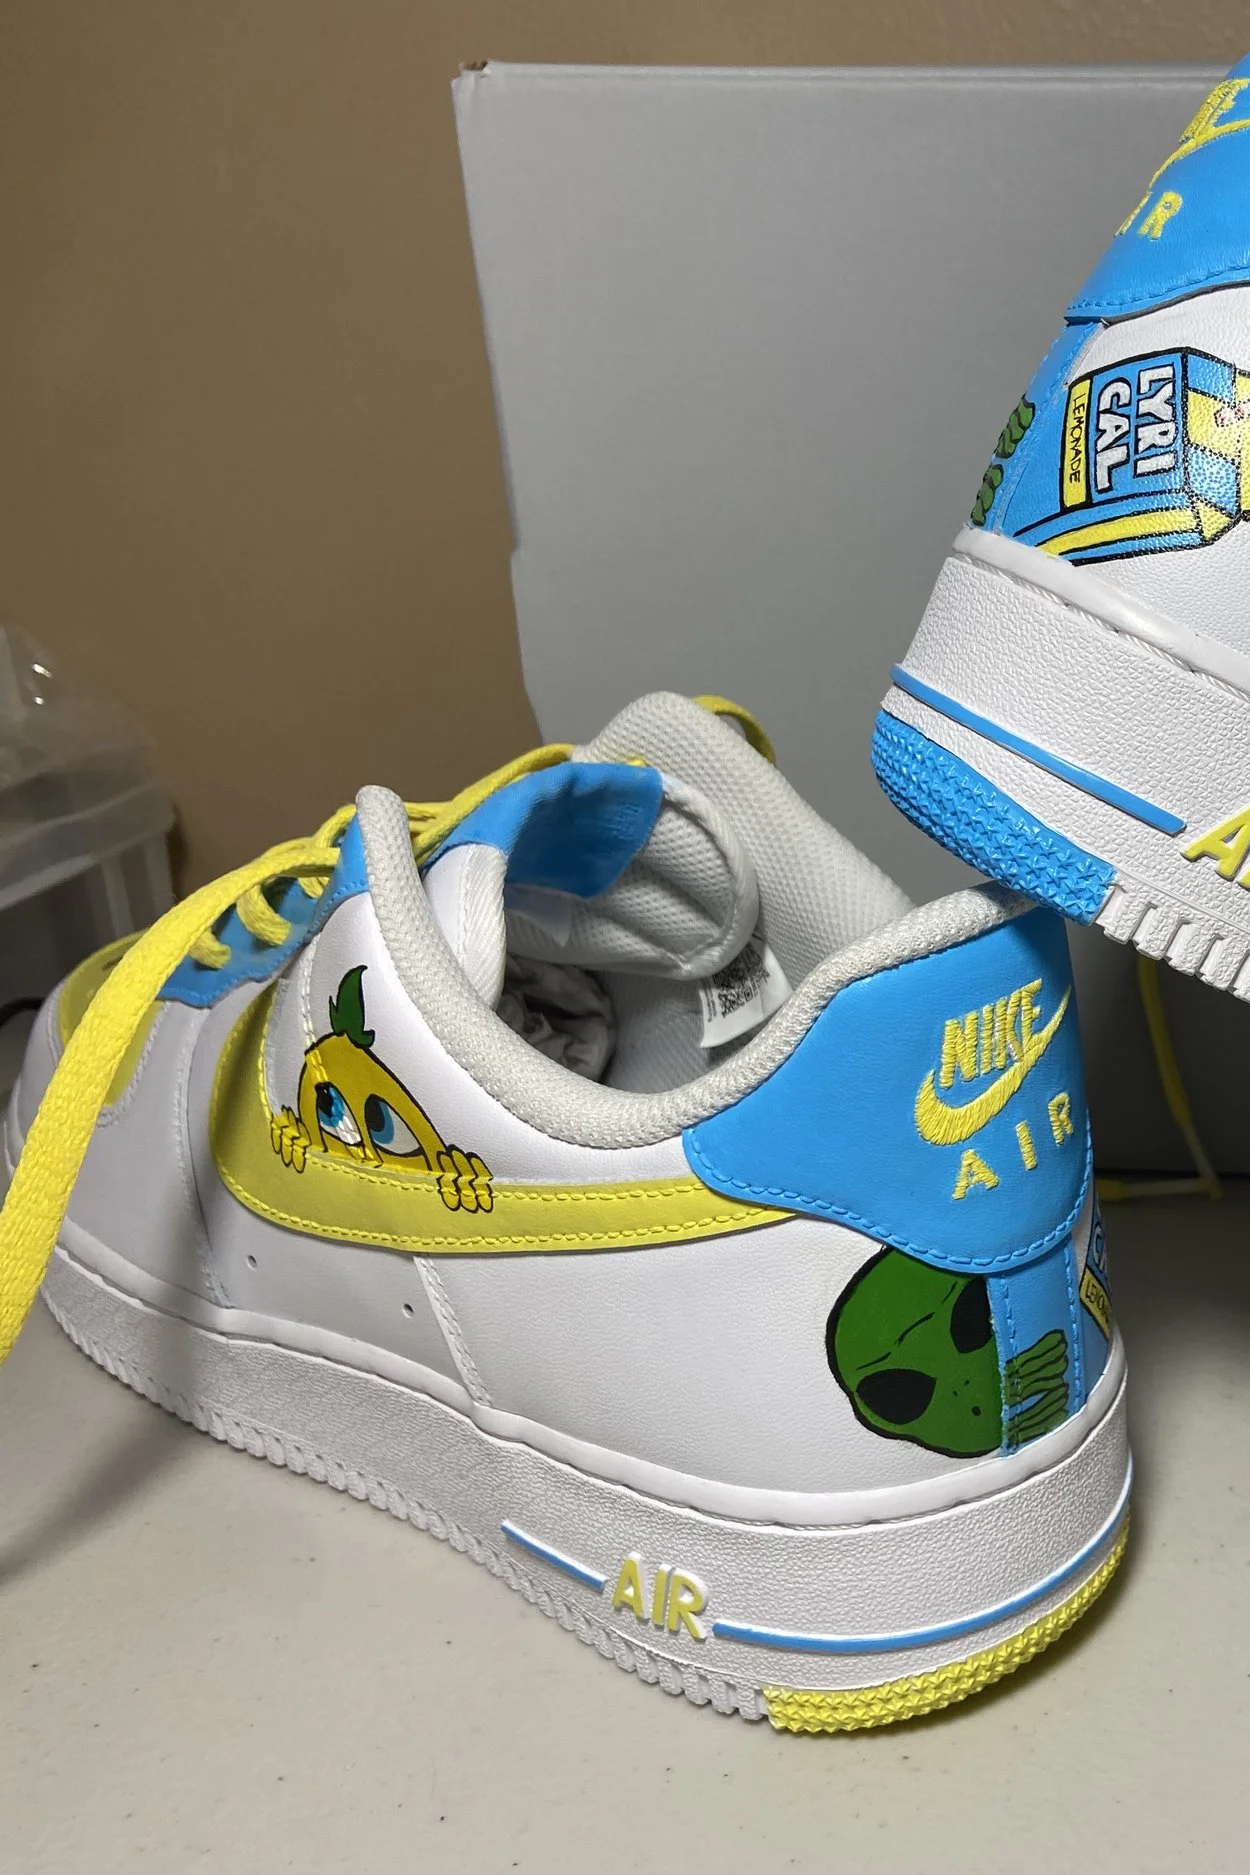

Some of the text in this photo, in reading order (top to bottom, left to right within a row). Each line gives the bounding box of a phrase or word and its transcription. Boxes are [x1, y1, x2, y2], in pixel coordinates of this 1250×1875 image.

[1069, 393, 1086, 484] LEMONADE
[1095, 377, 1131, 494] CAL
[1134, 362, 1177, 478] LYRI
[939, 978, 1042, 1089] NIKE
[952, 1092, 1074, 1200] AIR
[611, 1552, 708, 1642] AIR
